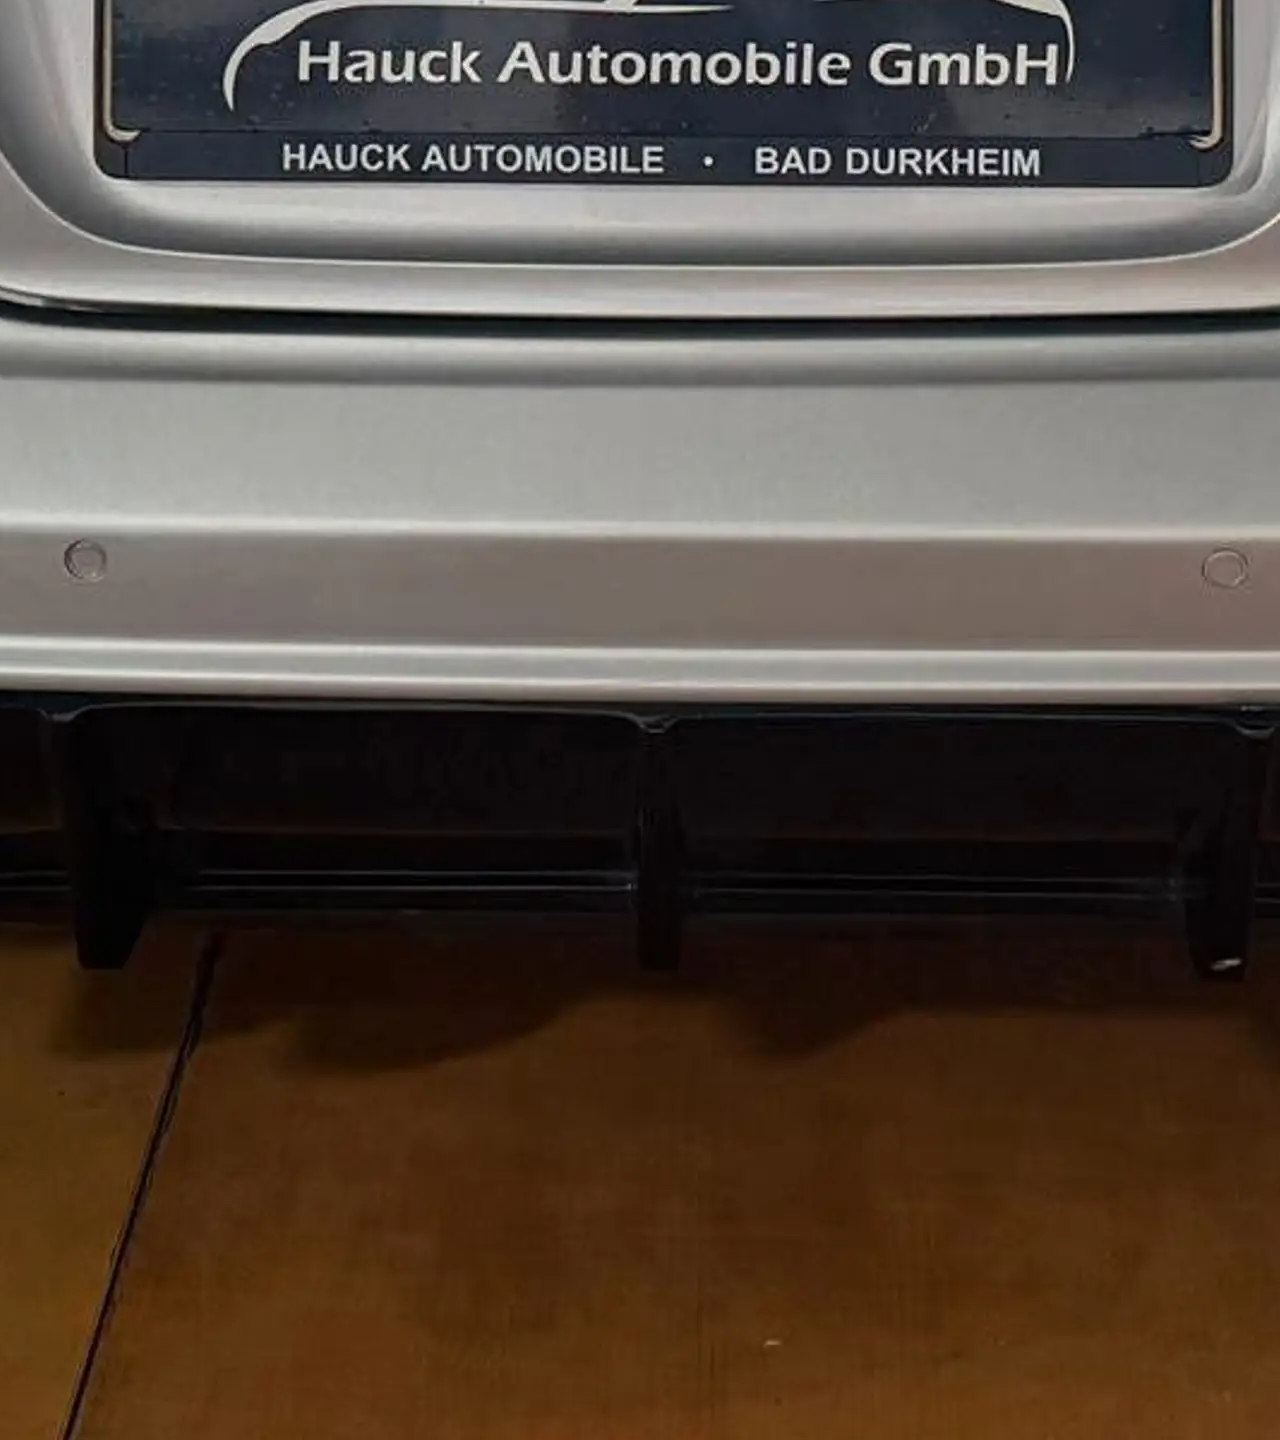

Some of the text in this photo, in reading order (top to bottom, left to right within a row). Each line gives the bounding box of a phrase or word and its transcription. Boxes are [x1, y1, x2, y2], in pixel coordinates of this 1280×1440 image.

[297, 40, 1059, 86] Hauck Automobile GmbH
[282, 143, 1040, 177] HAUCK AUTOMOBILE BAD DURKHEIM
